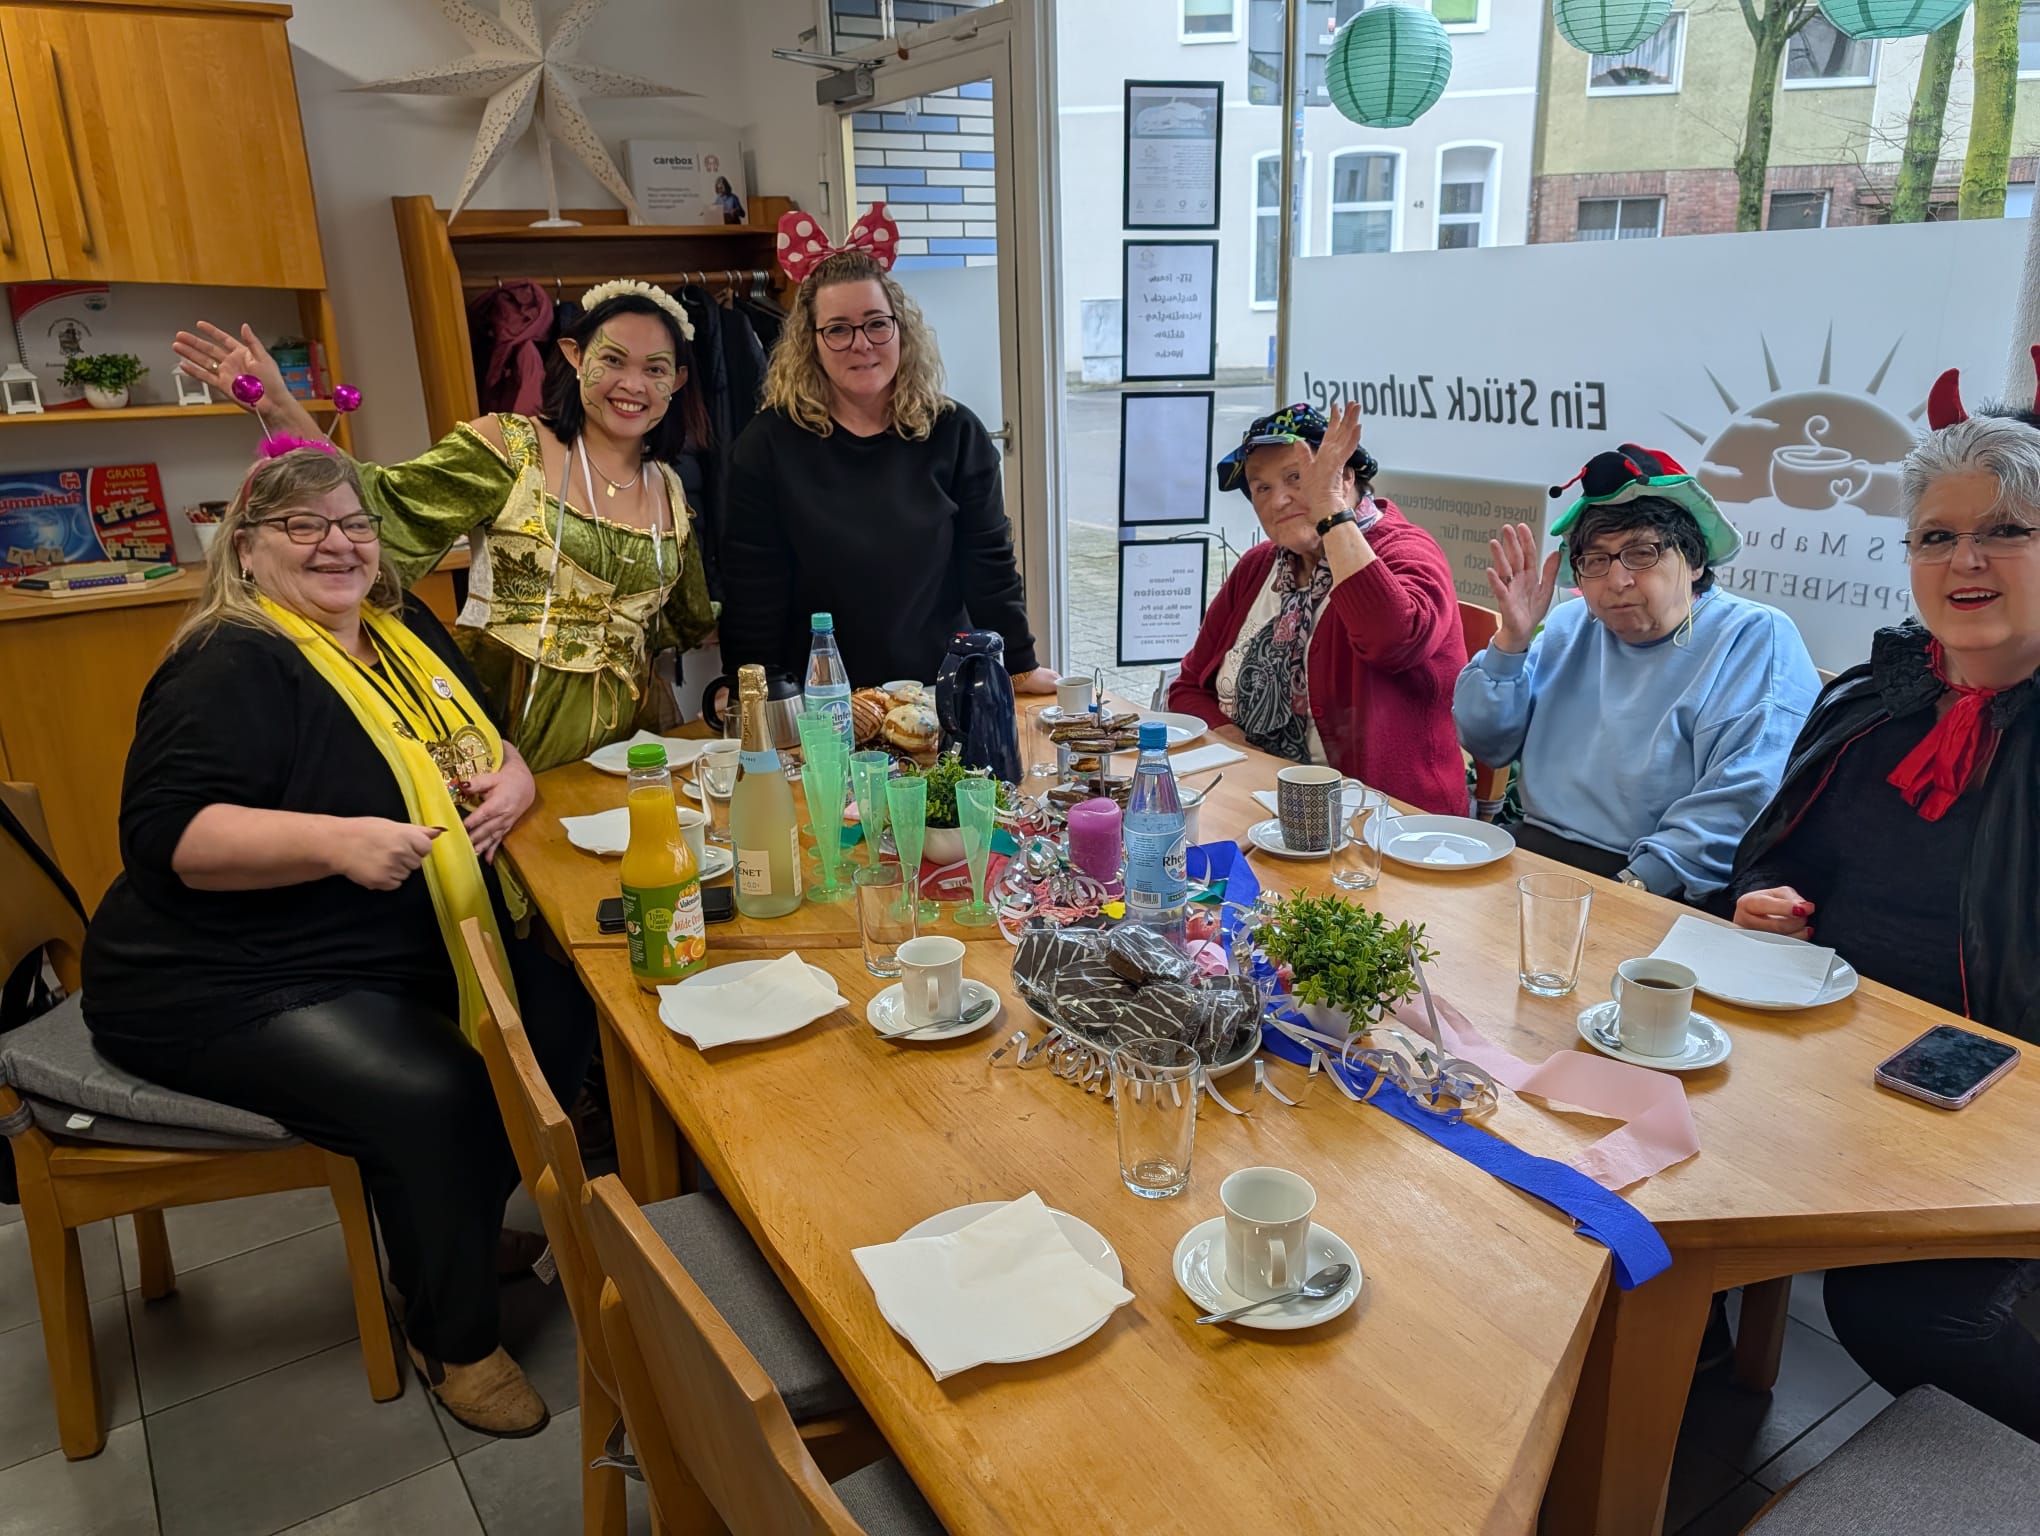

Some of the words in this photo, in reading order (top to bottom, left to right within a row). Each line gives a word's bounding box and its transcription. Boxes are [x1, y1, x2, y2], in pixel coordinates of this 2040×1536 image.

[653, 154, 693, 165] carebox
[106, 467, 147, 480] GRATIS
[674, 917, 692, 932] Milde
